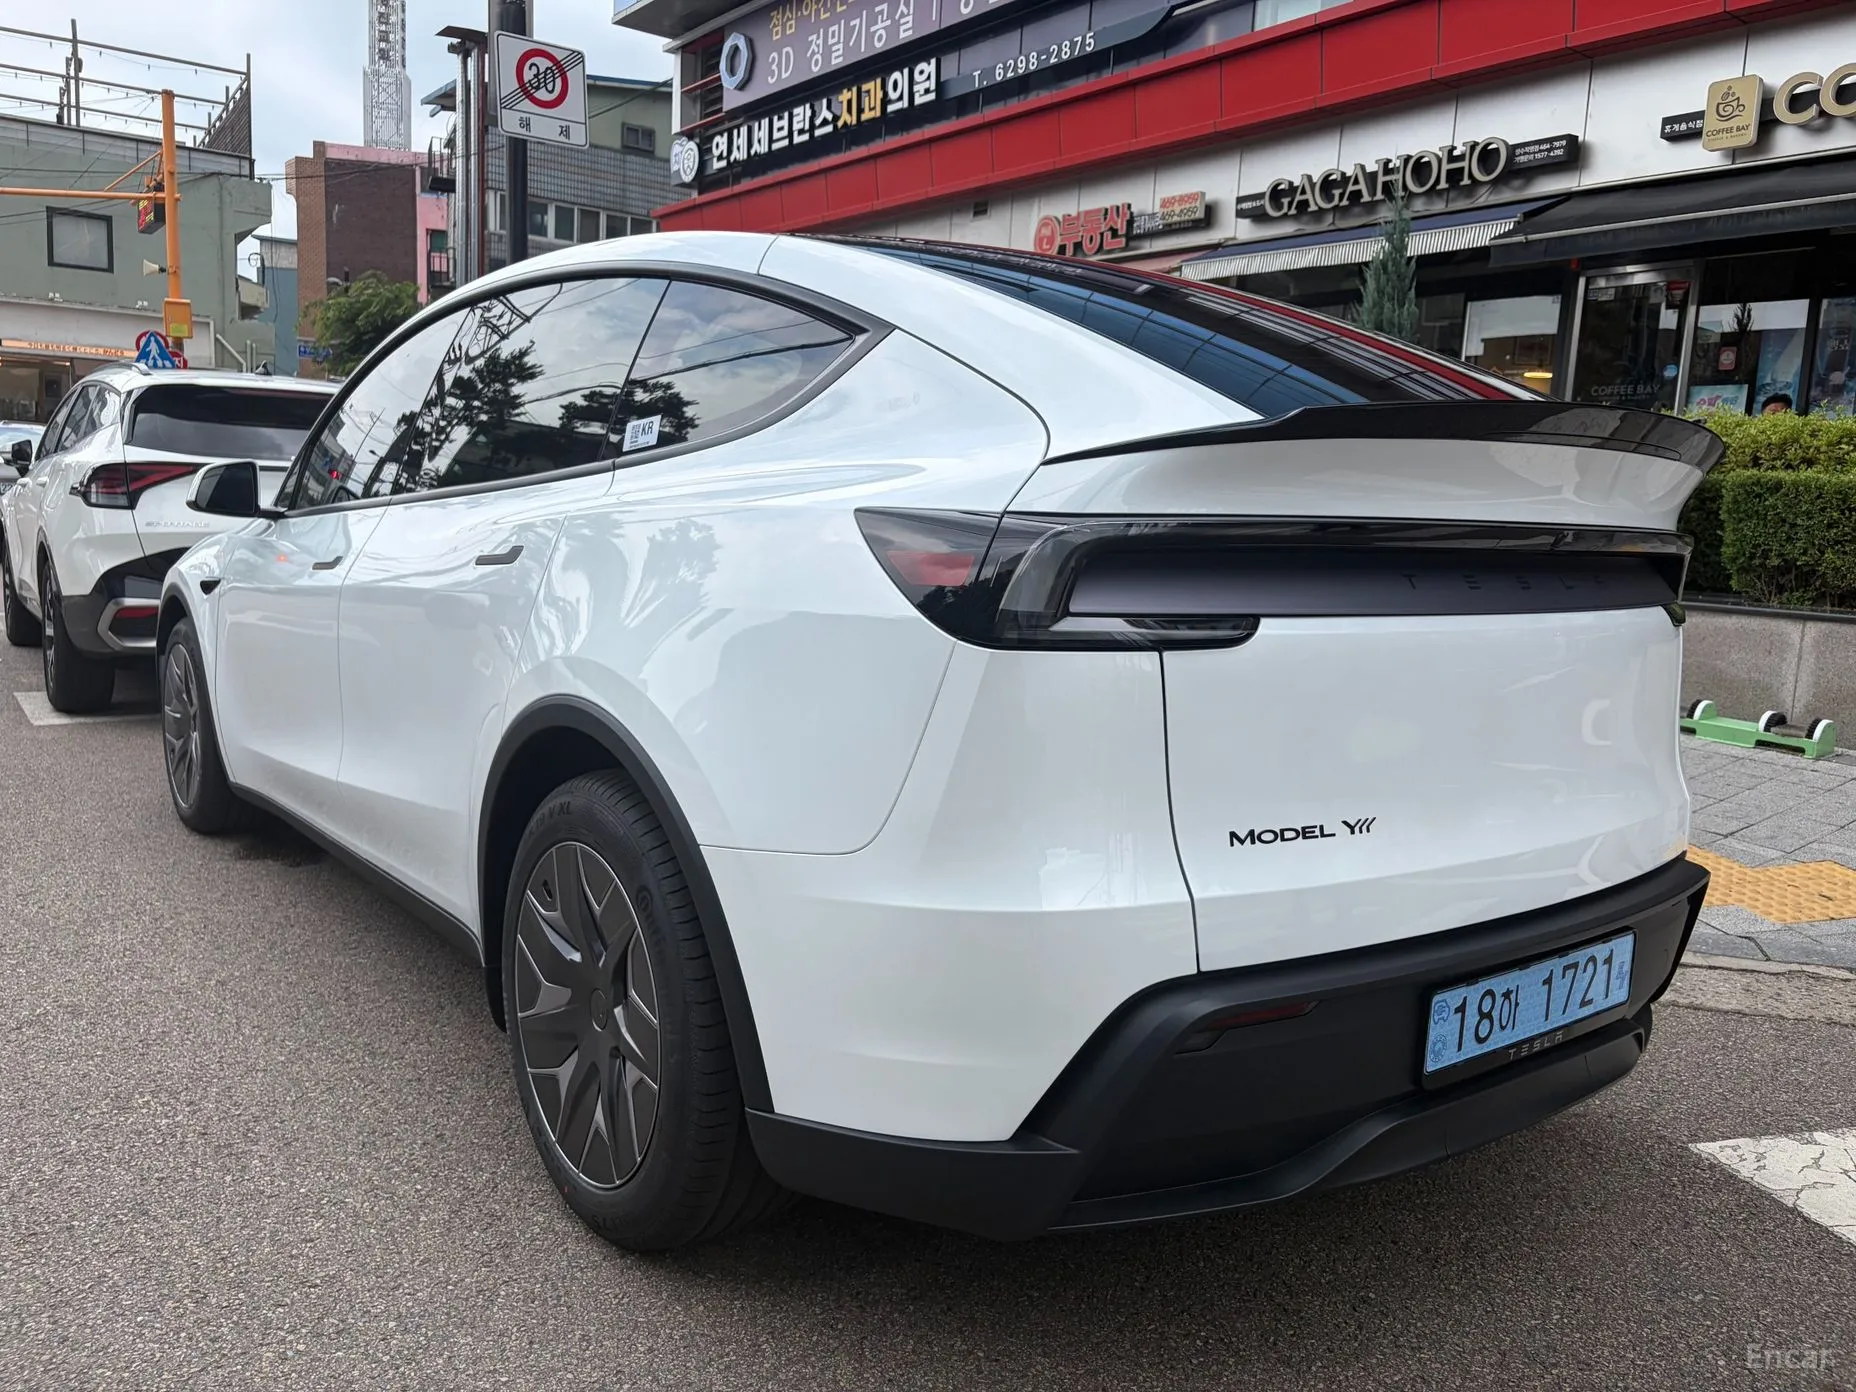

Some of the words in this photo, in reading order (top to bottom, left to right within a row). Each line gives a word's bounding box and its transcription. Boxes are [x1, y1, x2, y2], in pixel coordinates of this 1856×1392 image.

[768, 46, 794, 84] 3D
[807, 0, 914, 73] 정밀기공실
[973, 71, 988, 88] T.
[995, 32, 1095, 81] 6298-2875
[529, 62, 556, 94] 30
[519, 117, 531, 133] 해
[559, 124, 571, 140] 제
[712, 57, 937, 170] 연세세브란스치과의원
[1664, 120, 1704, 133] 휴게음식점
[1706, 126, 1735, 137] COFFEE
[1736, 123, 1751, 133] BAY
[1265, 137, 1508, 217] GAGAHOHO
[1059, 203, 1130, 256] 부동산
[1591, 385, 1634, 396] COFFEE
[641, 421, 654, 436] KR
[1229, 825, 1336, 847] MODEL
[1453, 984, 1520, 1053] 18하
[1542, 949, 1614, 1022] 1721
[1508, 1031, 1565, 1060] TESLA
